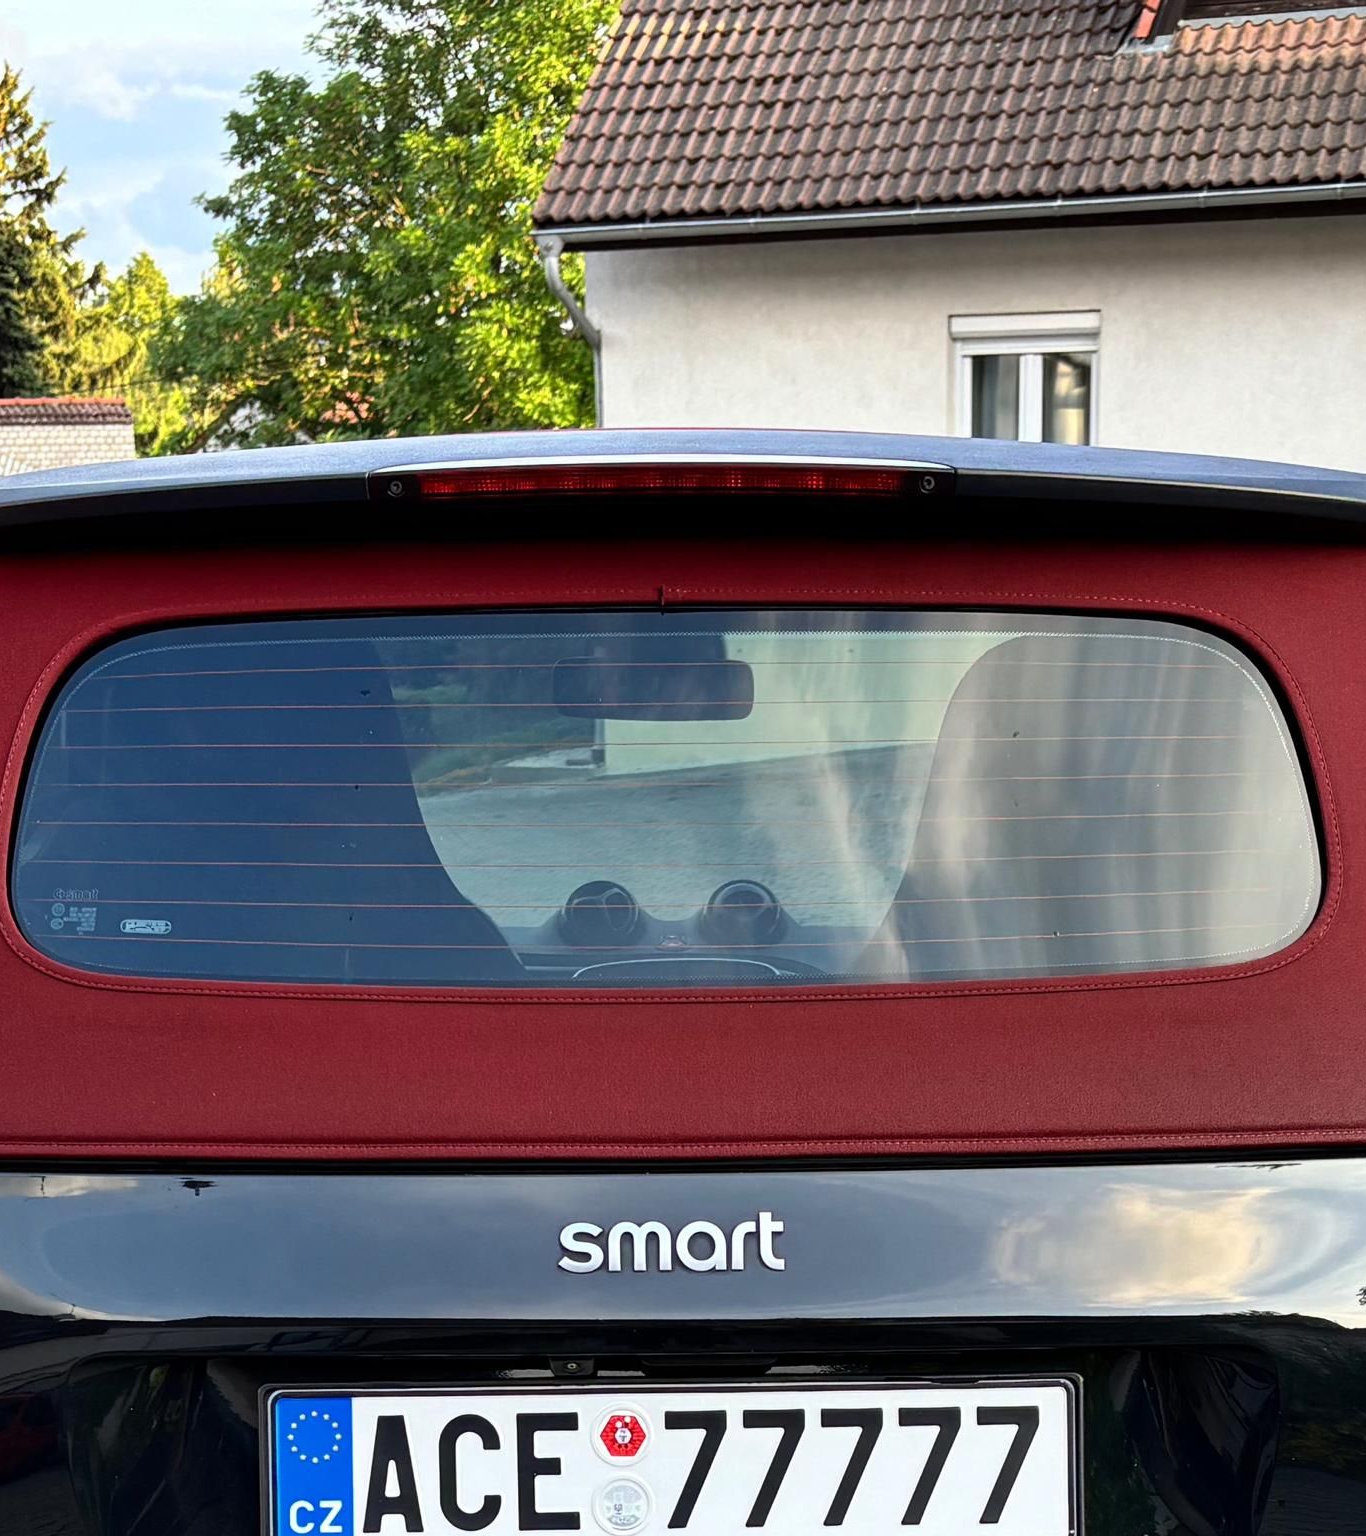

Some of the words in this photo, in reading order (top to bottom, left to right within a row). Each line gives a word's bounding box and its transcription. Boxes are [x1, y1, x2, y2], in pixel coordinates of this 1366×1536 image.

[558, 1211, 785, 1273] smart
[362, 1411, 581, 1534] ACE
[664, 1405, 1040, 1530] 77777
[288, 1500, 343, 1534] CZ
